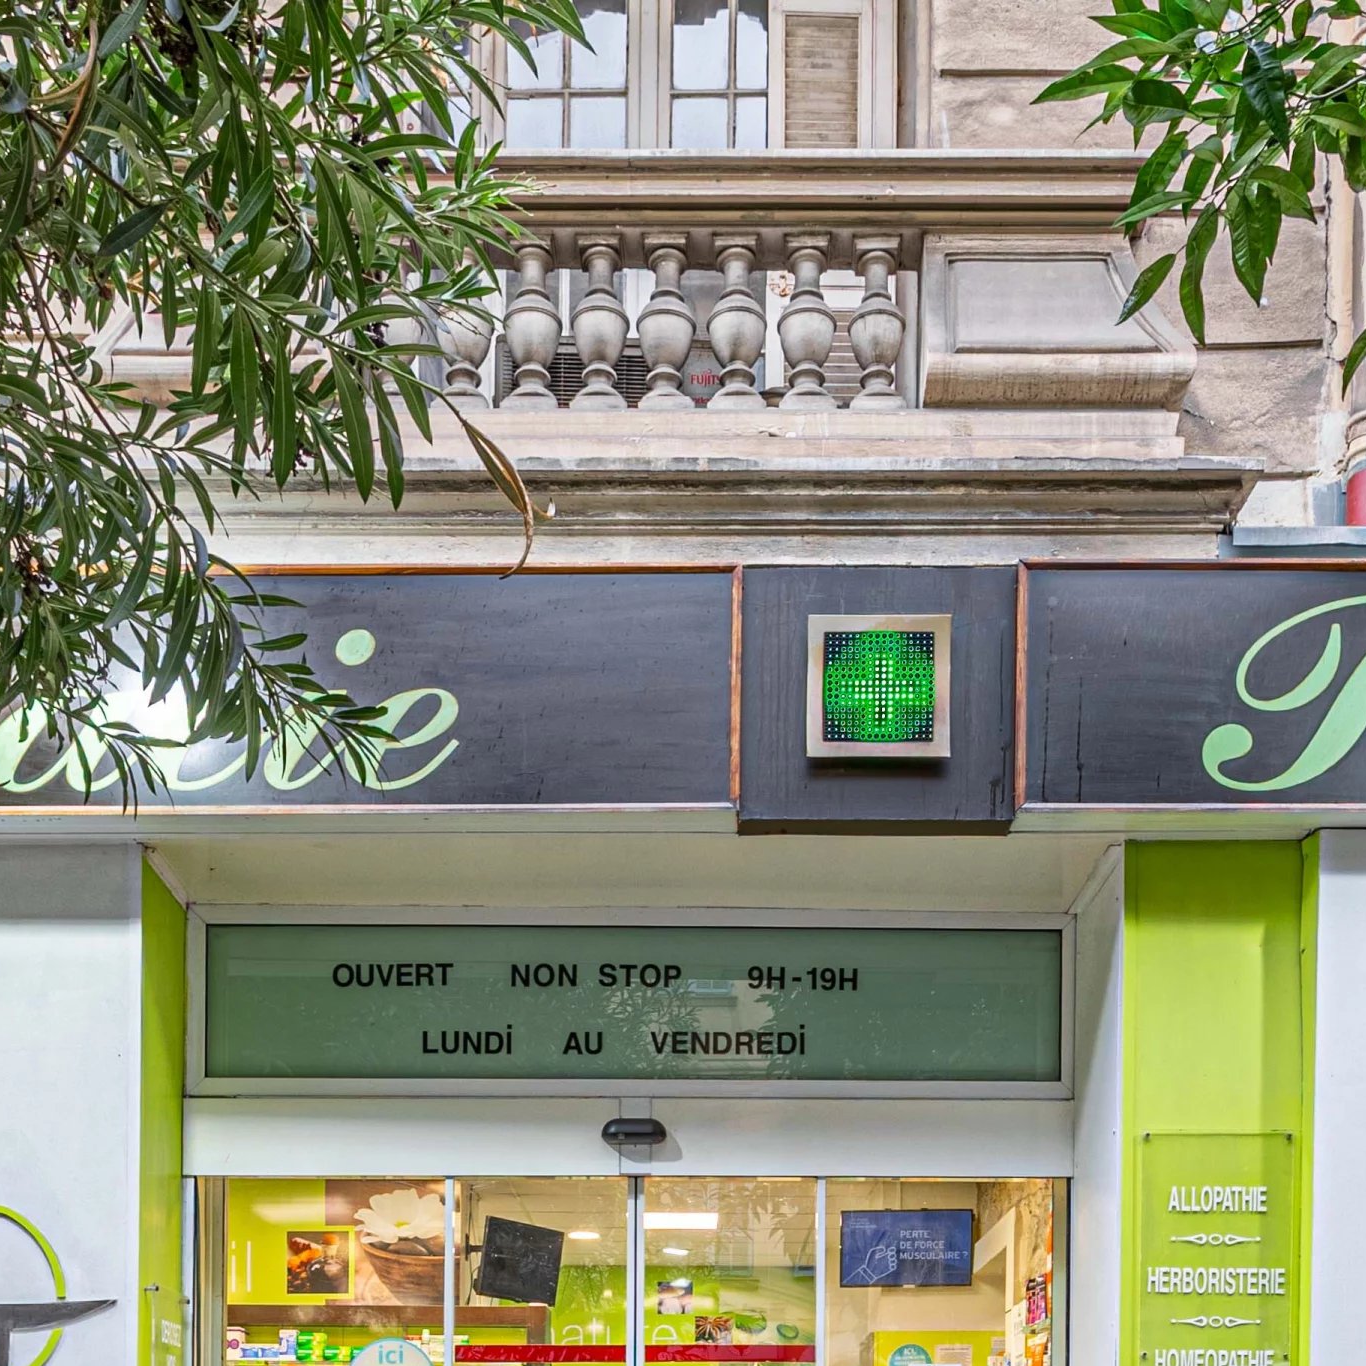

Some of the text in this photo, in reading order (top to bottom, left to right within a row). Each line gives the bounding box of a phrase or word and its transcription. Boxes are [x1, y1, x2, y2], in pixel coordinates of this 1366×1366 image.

[332, 963, 859, 992] OUVERT NON STOP 9H-19H
[563, 1031, 604, 1056] AU
[1168, 1186, 1267, 1213] ALLOPATHIE
[900, 1230, 930, 1238] PERTE
[900, 1241, 945, 1249] DE FORCE
[899, 1251, 960, 1260] MUSCULAIRE
[1147, 1267, 1285, 1296] HERBORISTERIE
[379, 1345, 403, 1364] ici
